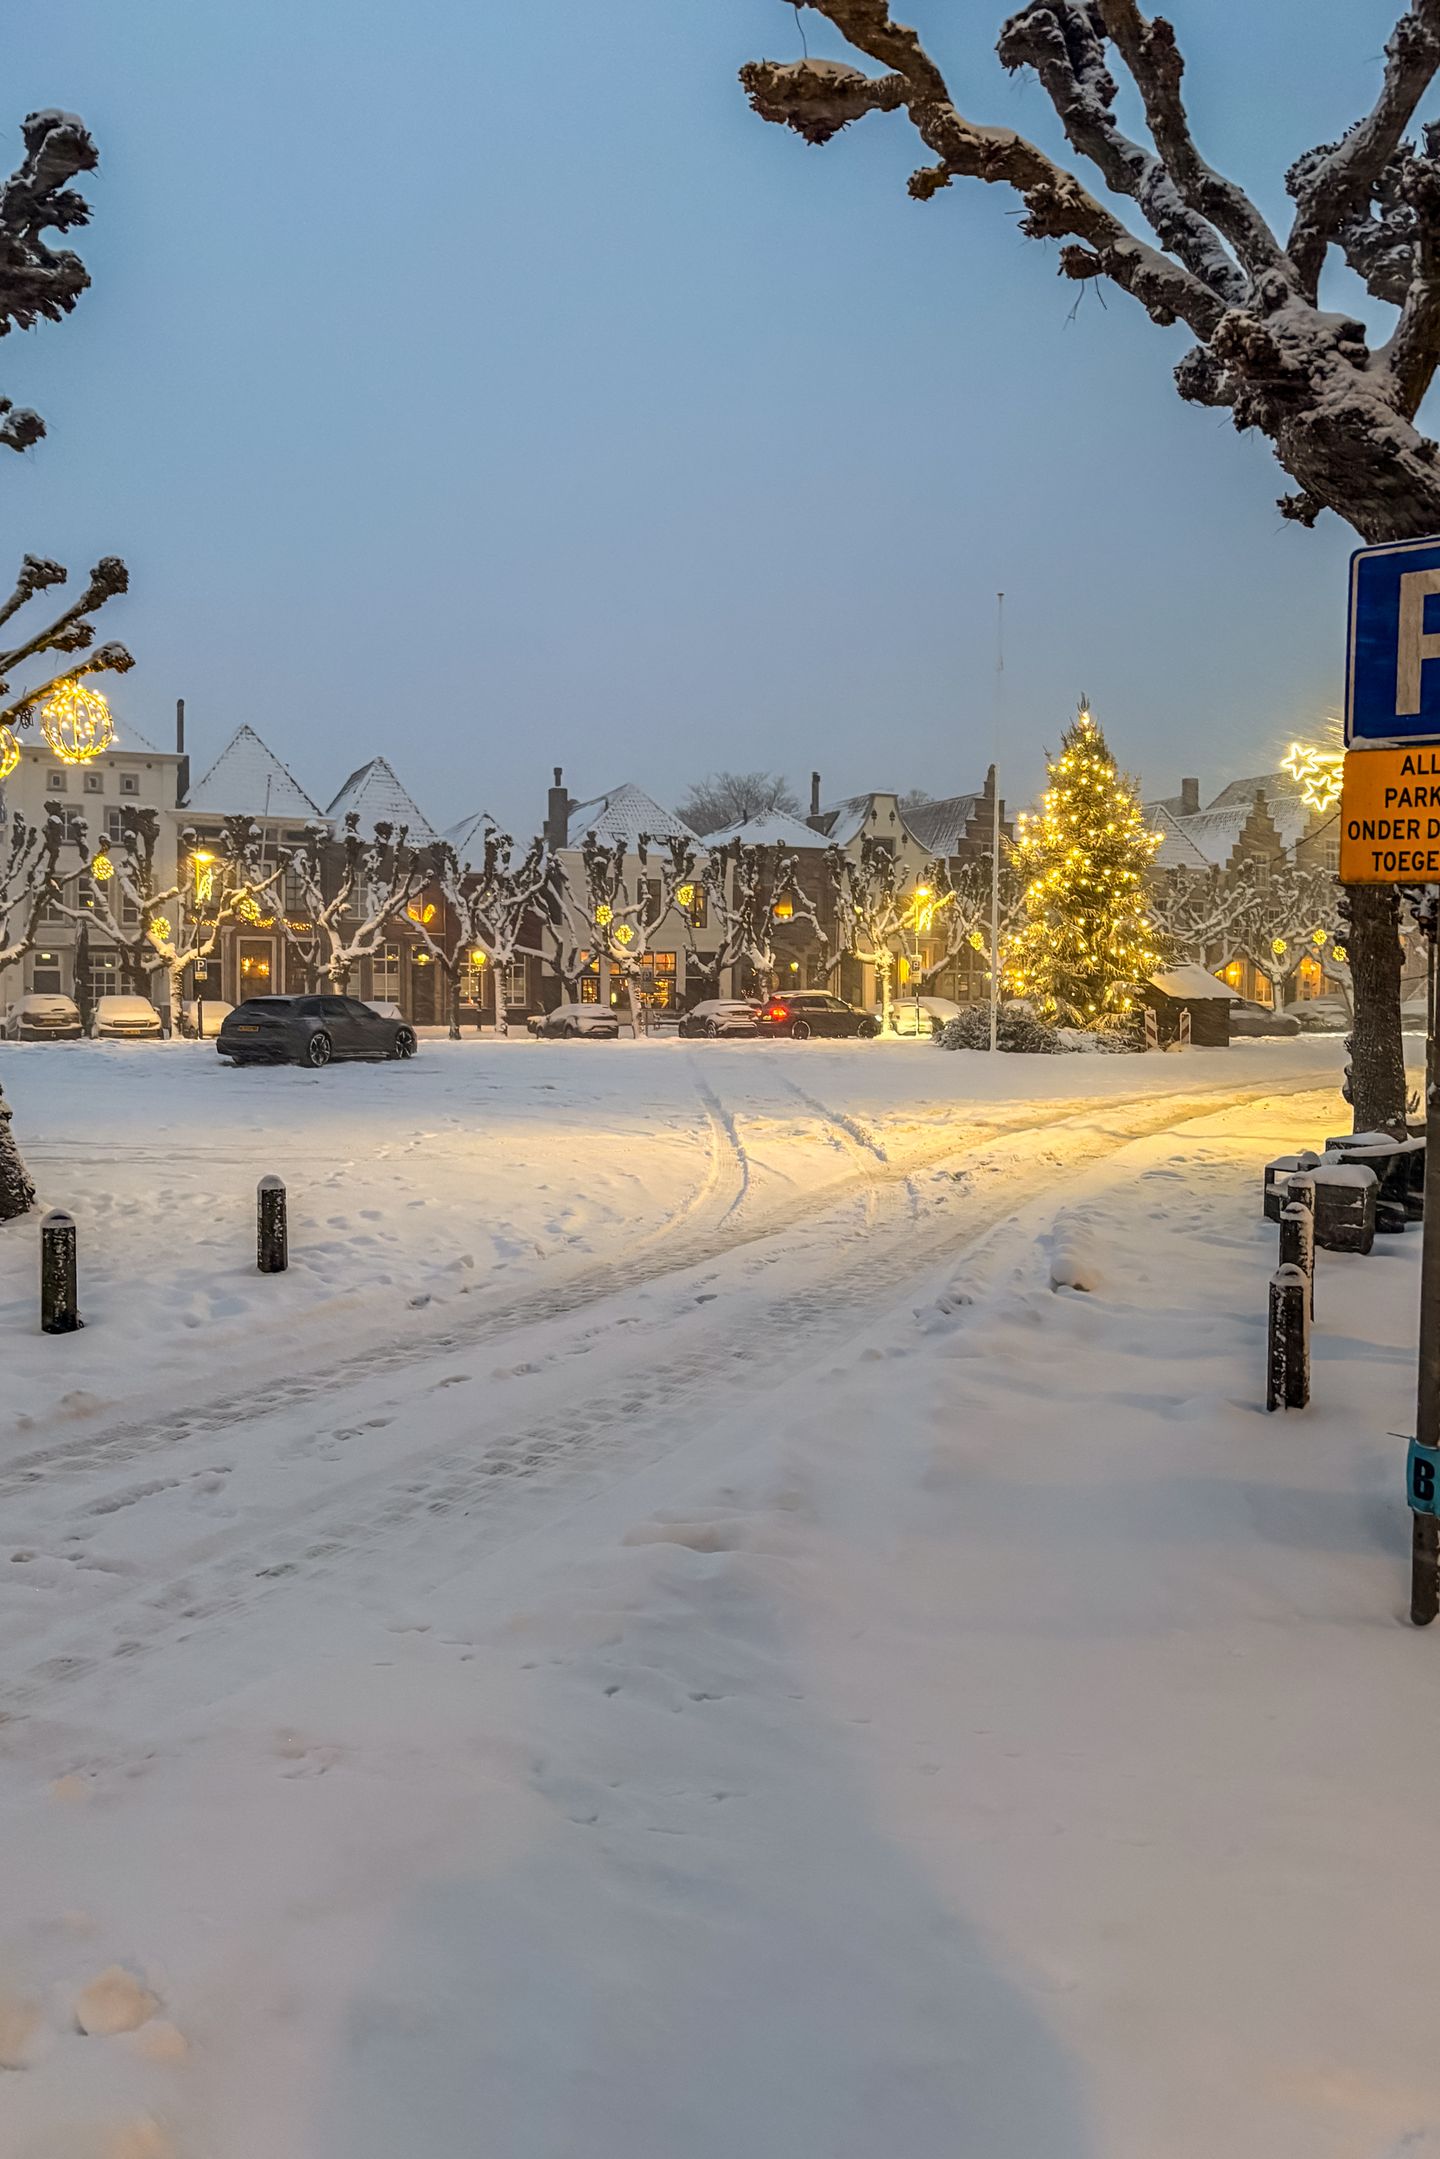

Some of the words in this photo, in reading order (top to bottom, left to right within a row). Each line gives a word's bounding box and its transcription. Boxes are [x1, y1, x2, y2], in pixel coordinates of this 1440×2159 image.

[1401, 754, 1440, 776] ALL
[1385, 786, 1440, 808] PARK
[1348, 819, 1420, 841] ONDER
[1428, 818, 1440, 839] D
[1371, 851, 1439, 872] TOEGE
[197, 960, 205, 971] P
[1414, 1457, 1435, 1502] B
